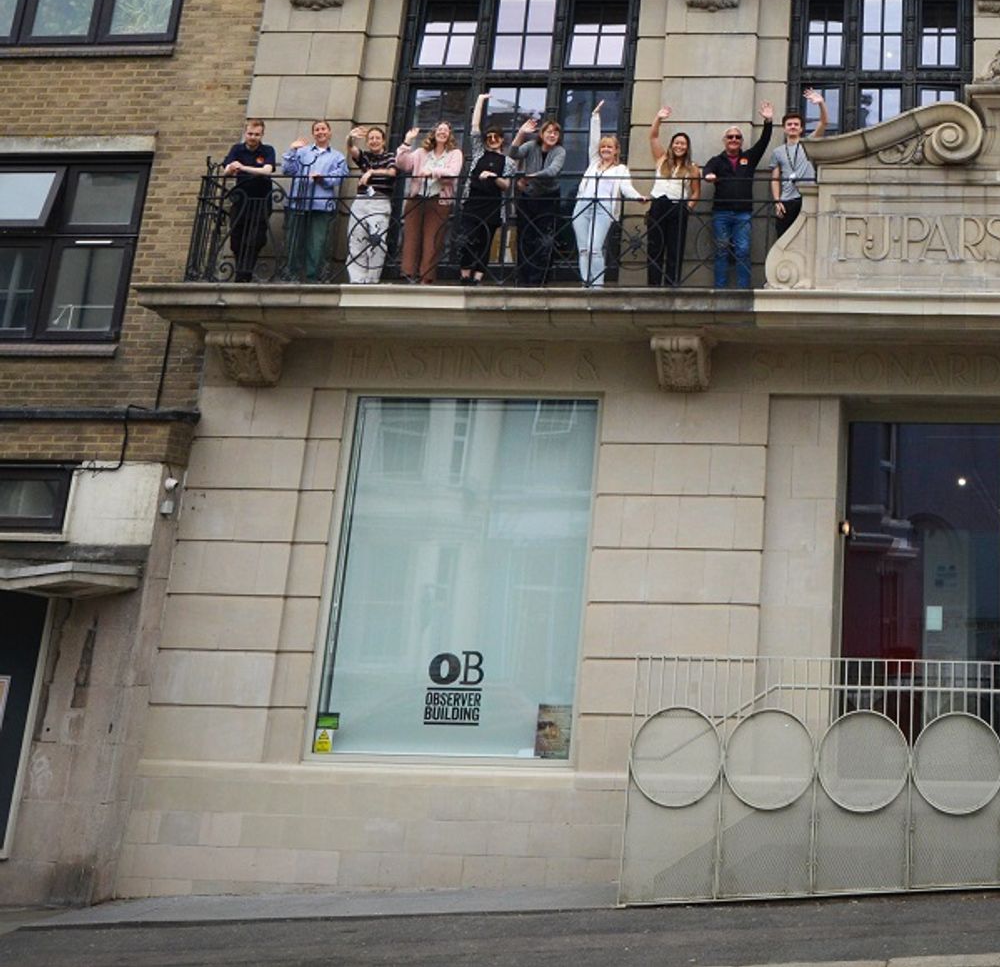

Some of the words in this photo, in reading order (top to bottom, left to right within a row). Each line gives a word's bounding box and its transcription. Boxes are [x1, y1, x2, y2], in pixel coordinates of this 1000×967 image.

[344, 345, 547, 380] HASTINGS
[428, 650, 485, 685] OB
[425, 692, 482, 706] OBSERVER
[423, 706, 480, 721] BUILDING
